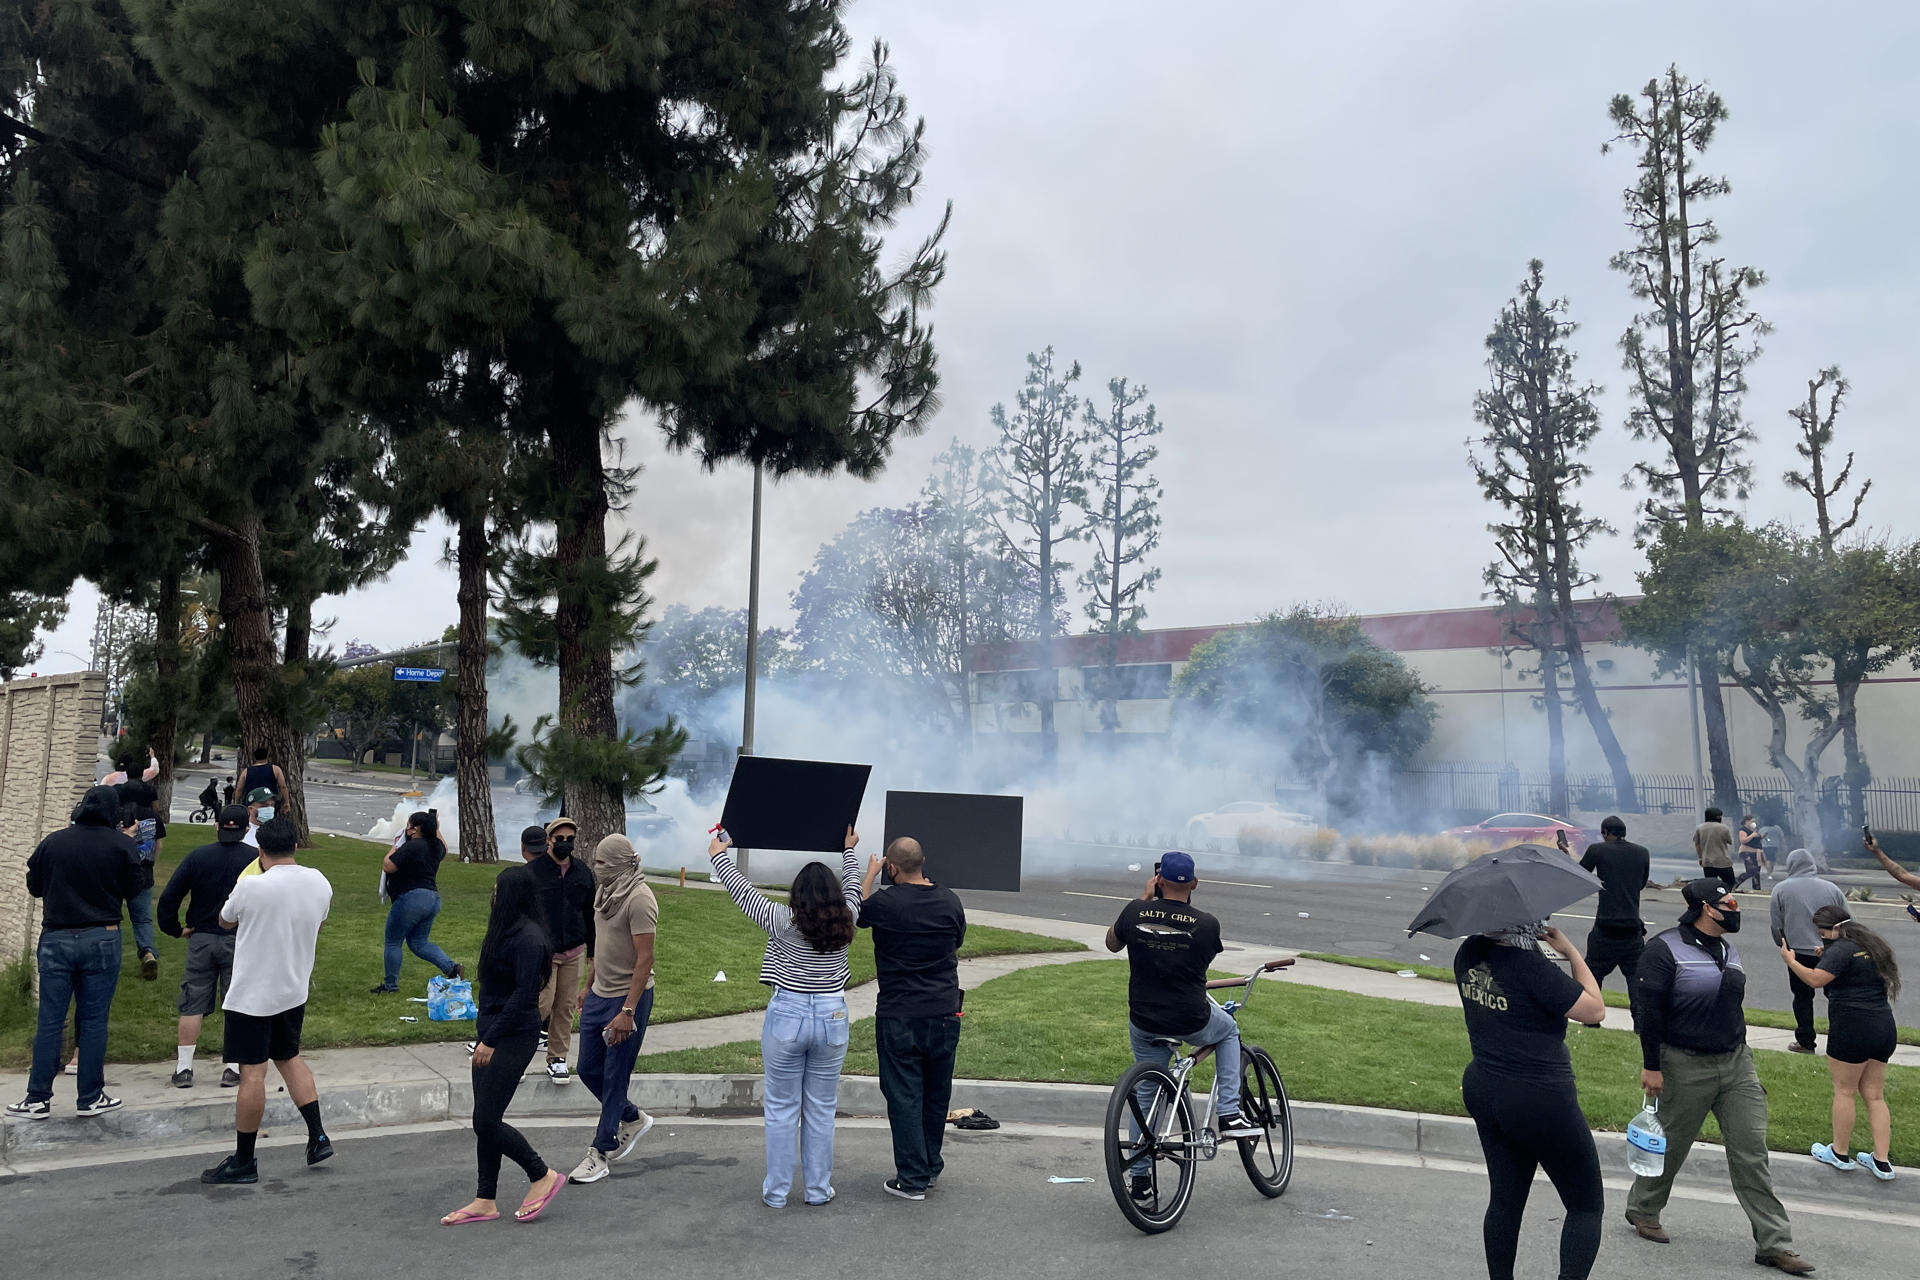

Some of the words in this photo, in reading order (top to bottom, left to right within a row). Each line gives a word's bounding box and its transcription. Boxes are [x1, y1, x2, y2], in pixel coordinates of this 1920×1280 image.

[406, 669, 424, 677] Home
[1139, 910, 1167, 919] SALTY
[1171, 913, 1197, 924] CREW
[1461, 982, 1508, 1011] MEXICO
